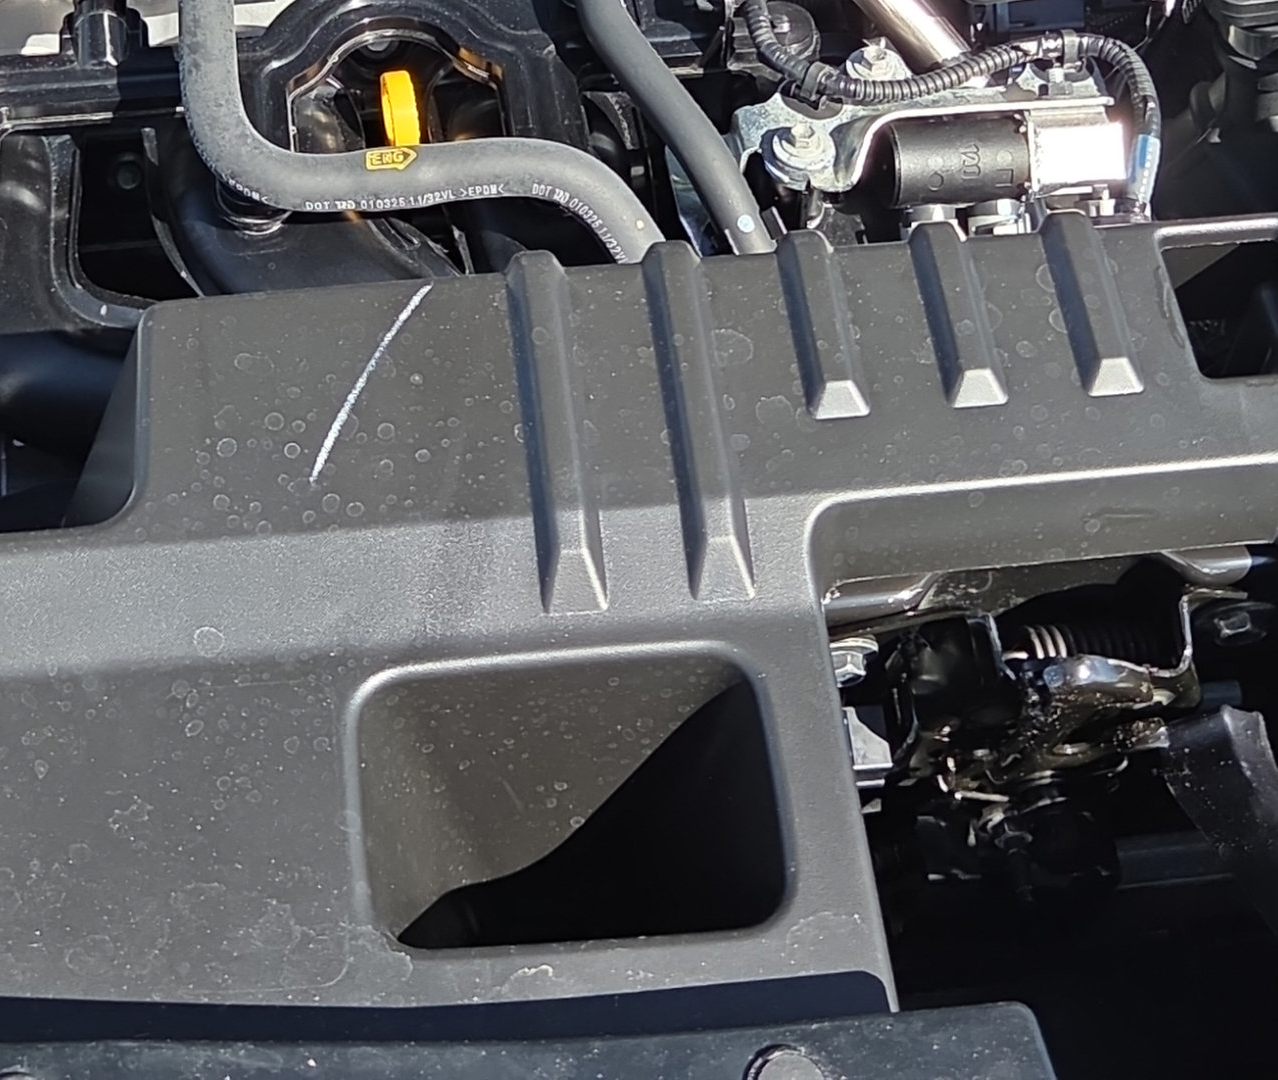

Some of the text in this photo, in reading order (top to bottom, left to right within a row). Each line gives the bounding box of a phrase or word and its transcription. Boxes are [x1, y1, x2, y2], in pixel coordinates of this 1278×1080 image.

[369, 150, 404, 166] ENG
[531, 182, 553, 196] DOT
[304, 200, 332, 212] DOT
[459, 183, 506, 198] >EPDM<
